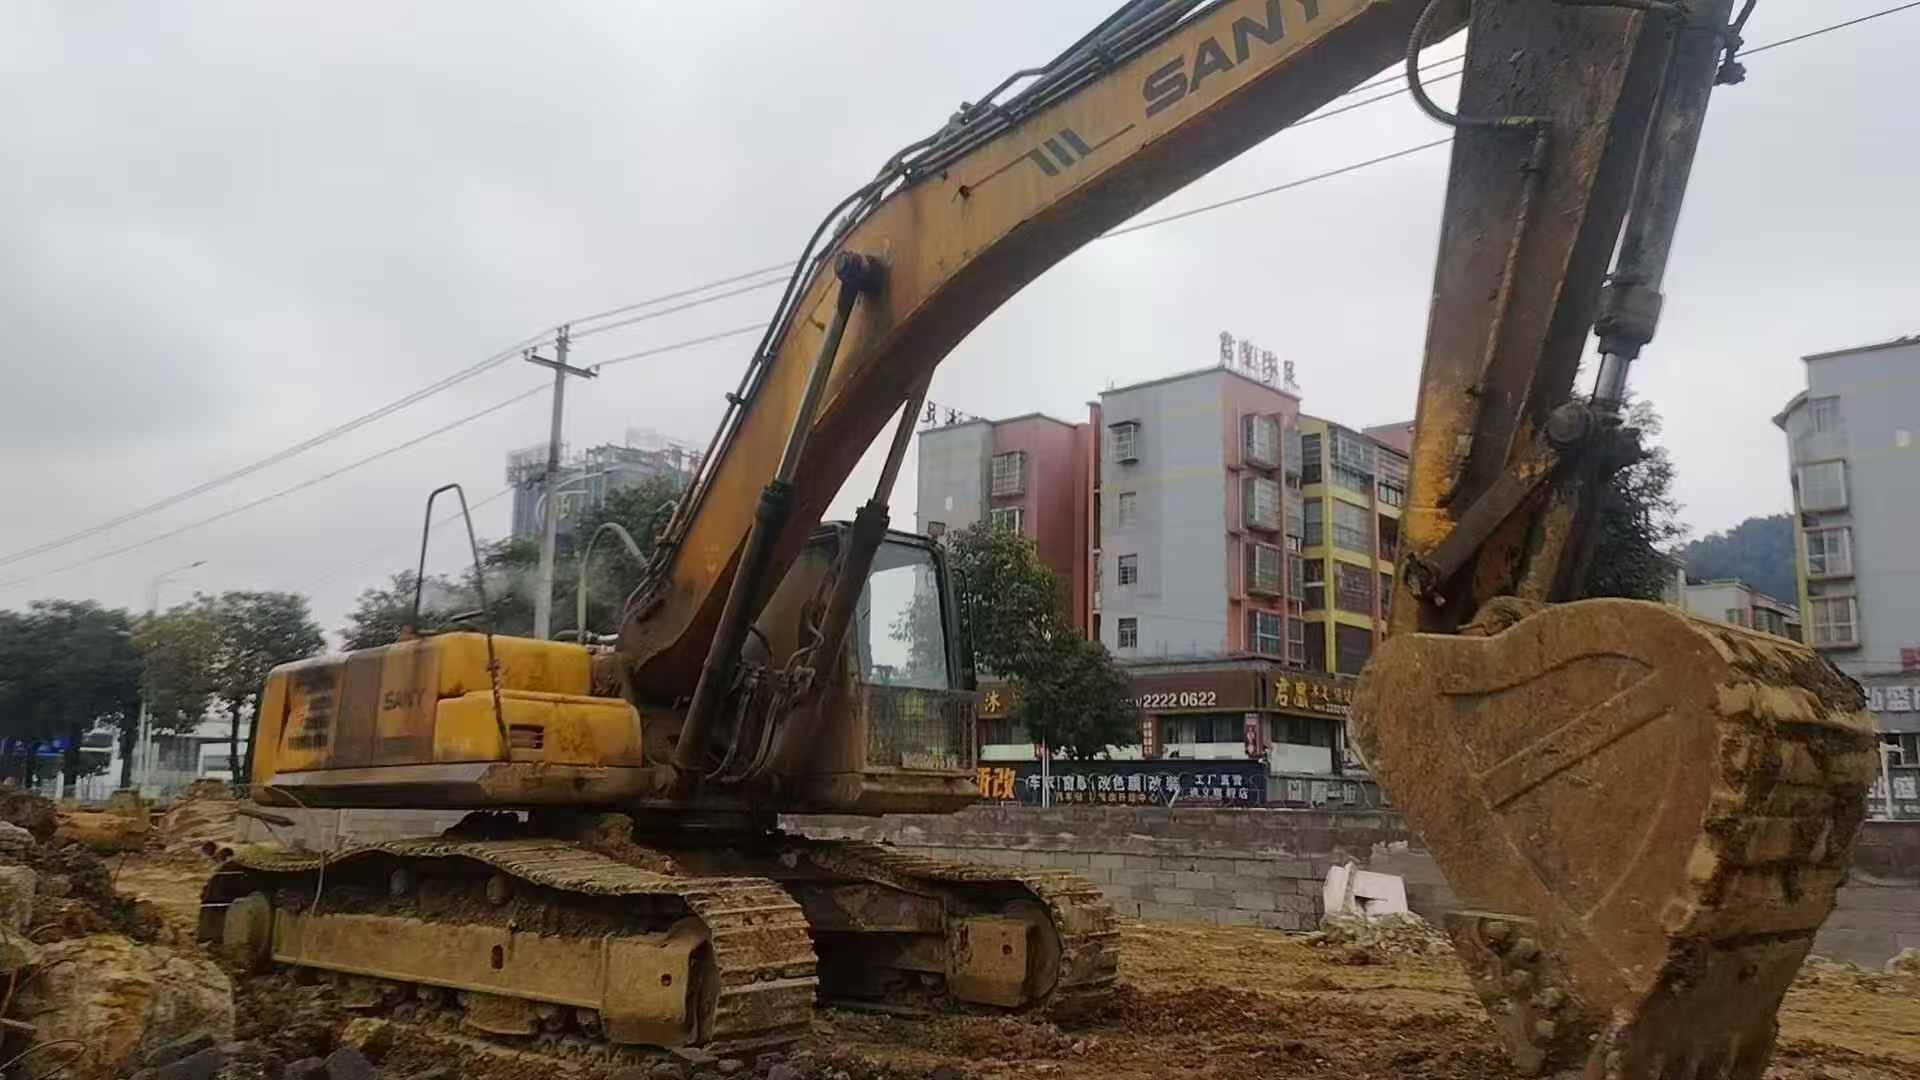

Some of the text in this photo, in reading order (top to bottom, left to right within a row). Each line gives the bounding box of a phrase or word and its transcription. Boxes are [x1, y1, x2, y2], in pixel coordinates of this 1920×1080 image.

[384, 688, 426, 711] SANY
[1143, 693, 1177, 708] 2222
[1179, 691, 1216, 707] 0622
